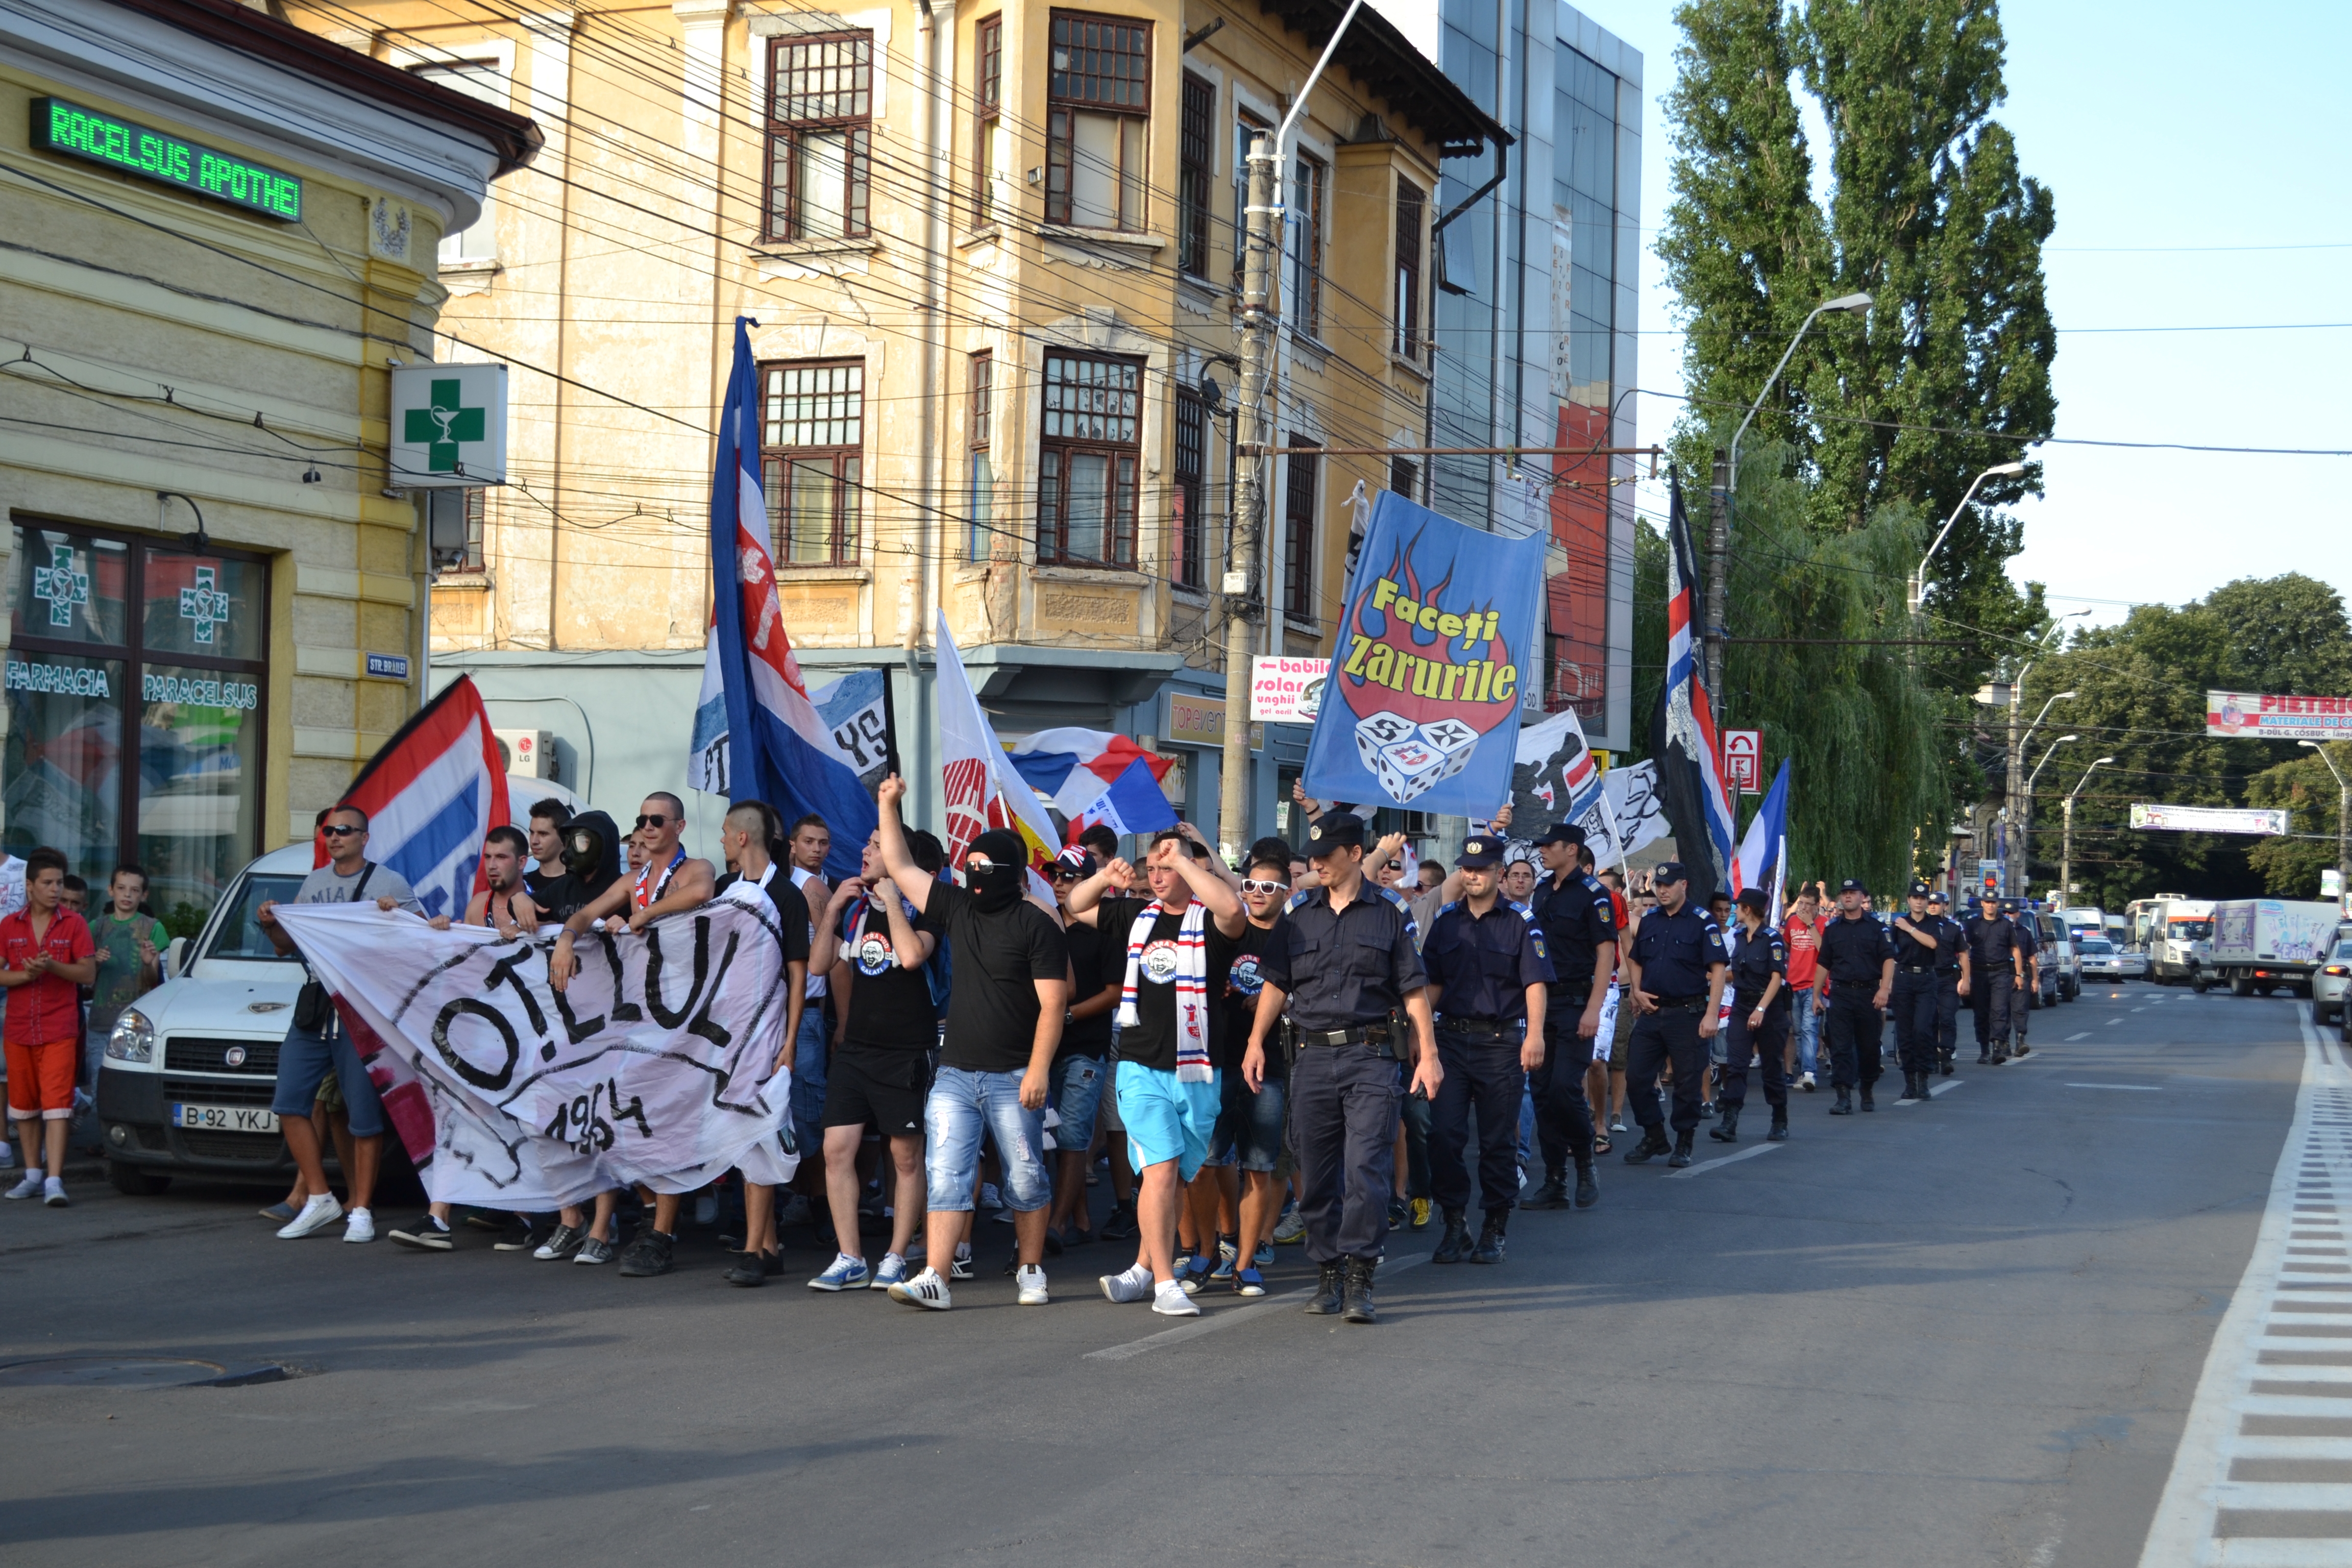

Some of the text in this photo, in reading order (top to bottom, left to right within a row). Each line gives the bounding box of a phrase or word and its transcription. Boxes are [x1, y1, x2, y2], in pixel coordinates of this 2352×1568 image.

[53, 106, 298, 216] RACELSUS APOTHE
[370, 658, 383, 672] STR.
[1343, 633, 1517, 702] Zarurile
[6, 660, 110, 698] FARMACIA
[1255, 677, 1304, 692] solar
[143, 674, 257, 710] PARACELSUS
[1257, 695, 1295, 706] unghii
[2259, 716, 2322, 727] MATERIALE
[2323, 717, 2339, 727] DE
[1146, 941, 1169, 953] ULTRA
[2281, 943, 2311, 961] Easy
[1235, 954, 1258, 965] ULTRA
[230, 1051, 242, 1061] FIAT
[186, 1107, 271, 1130] B 92 YKJ
[545, 1077, 653, 1155] 1964
